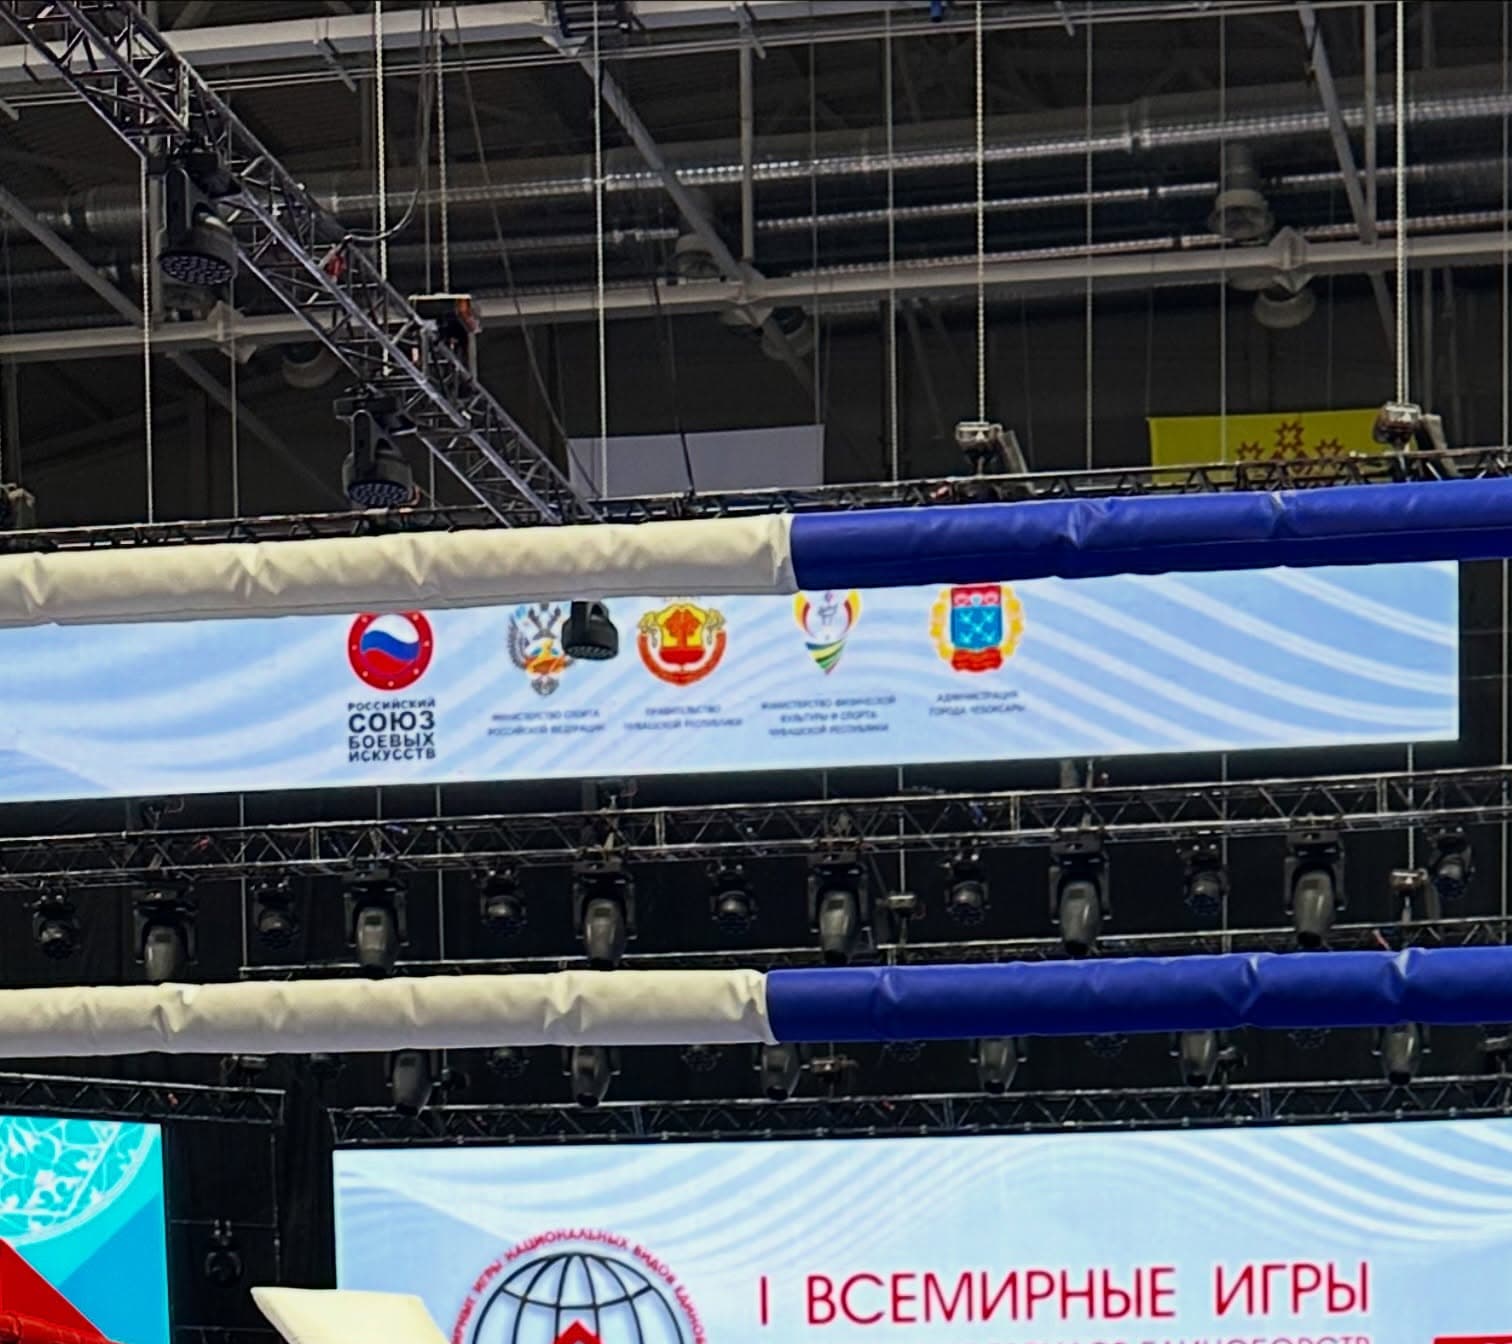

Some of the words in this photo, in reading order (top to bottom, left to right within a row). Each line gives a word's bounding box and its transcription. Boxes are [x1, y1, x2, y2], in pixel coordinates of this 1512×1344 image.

[348, 698, 436, 712] РОССИЙСКИЙ
[348, 710, 436, 734] СОЮЗ
[348, 732, 435, 749] БОЕВЫХ
[348, 748, 436, 762] ИСКУССТВ
[807, 1267, 1176, 1325] ВСЕМИРНЫЕ
[1216, 1261, 1368, 1315] ИГРЫ
